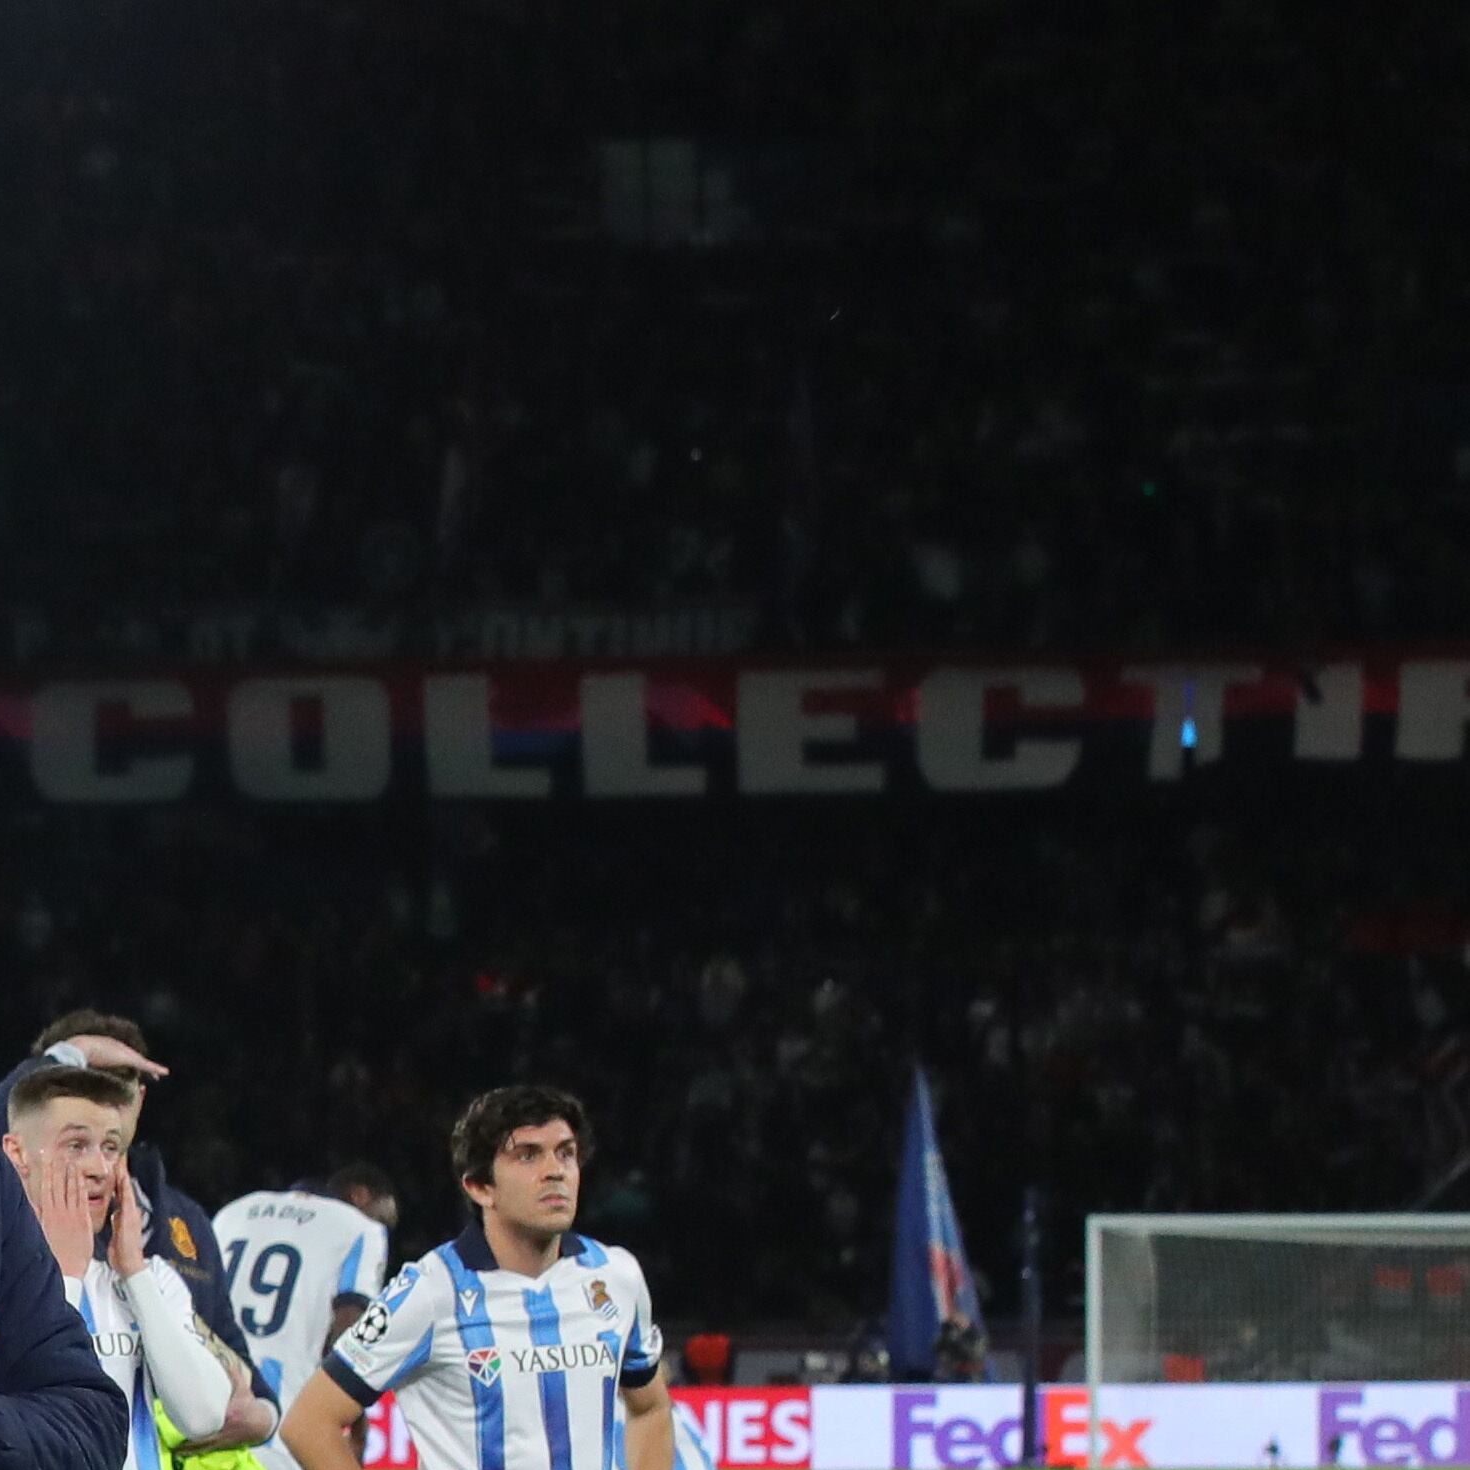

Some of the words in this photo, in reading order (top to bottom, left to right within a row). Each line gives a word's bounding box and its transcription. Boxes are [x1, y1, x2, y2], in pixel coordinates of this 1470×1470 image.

[226, 1239, 302, 1338] 19
[510, 1343, 615, 1372] YASUDA
[1320, 1389, 1470, 1468] Fed
